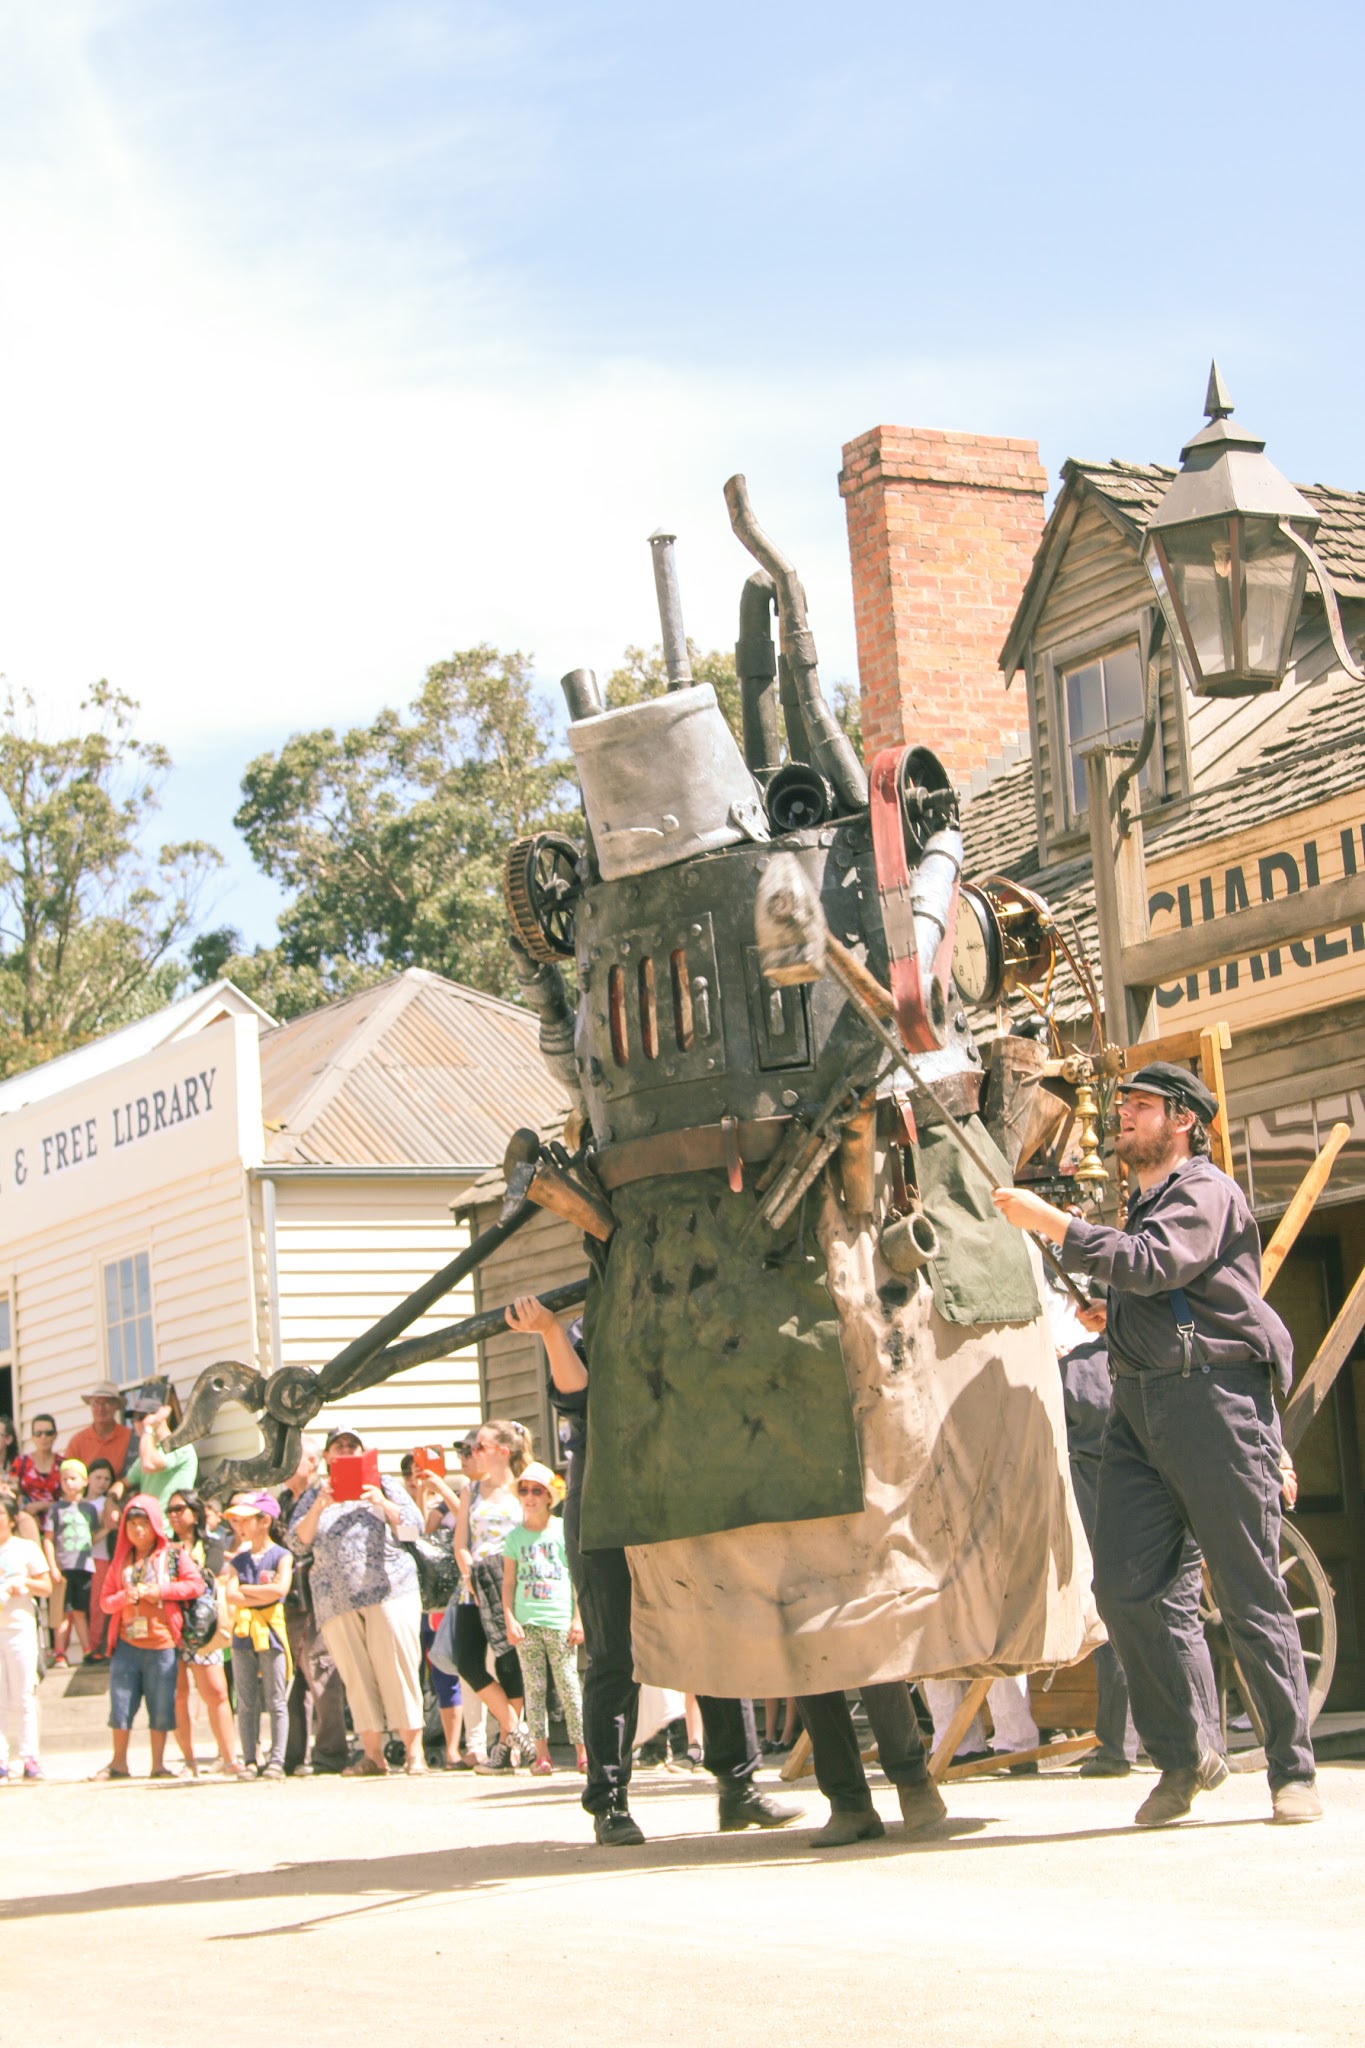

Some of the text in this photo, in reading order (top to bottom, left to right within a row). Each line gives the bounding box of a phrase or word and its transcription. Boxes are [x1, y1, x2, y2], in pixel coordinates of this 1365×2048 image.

[1148, 823, 1365, 1008] CHARLI
[953, 945, 959, 957] 9
[959, 965, 964, 976] 8
[967, 978, 972, 990] 7
[15, 1067, 216, 1185] & FREE LIBRARY
